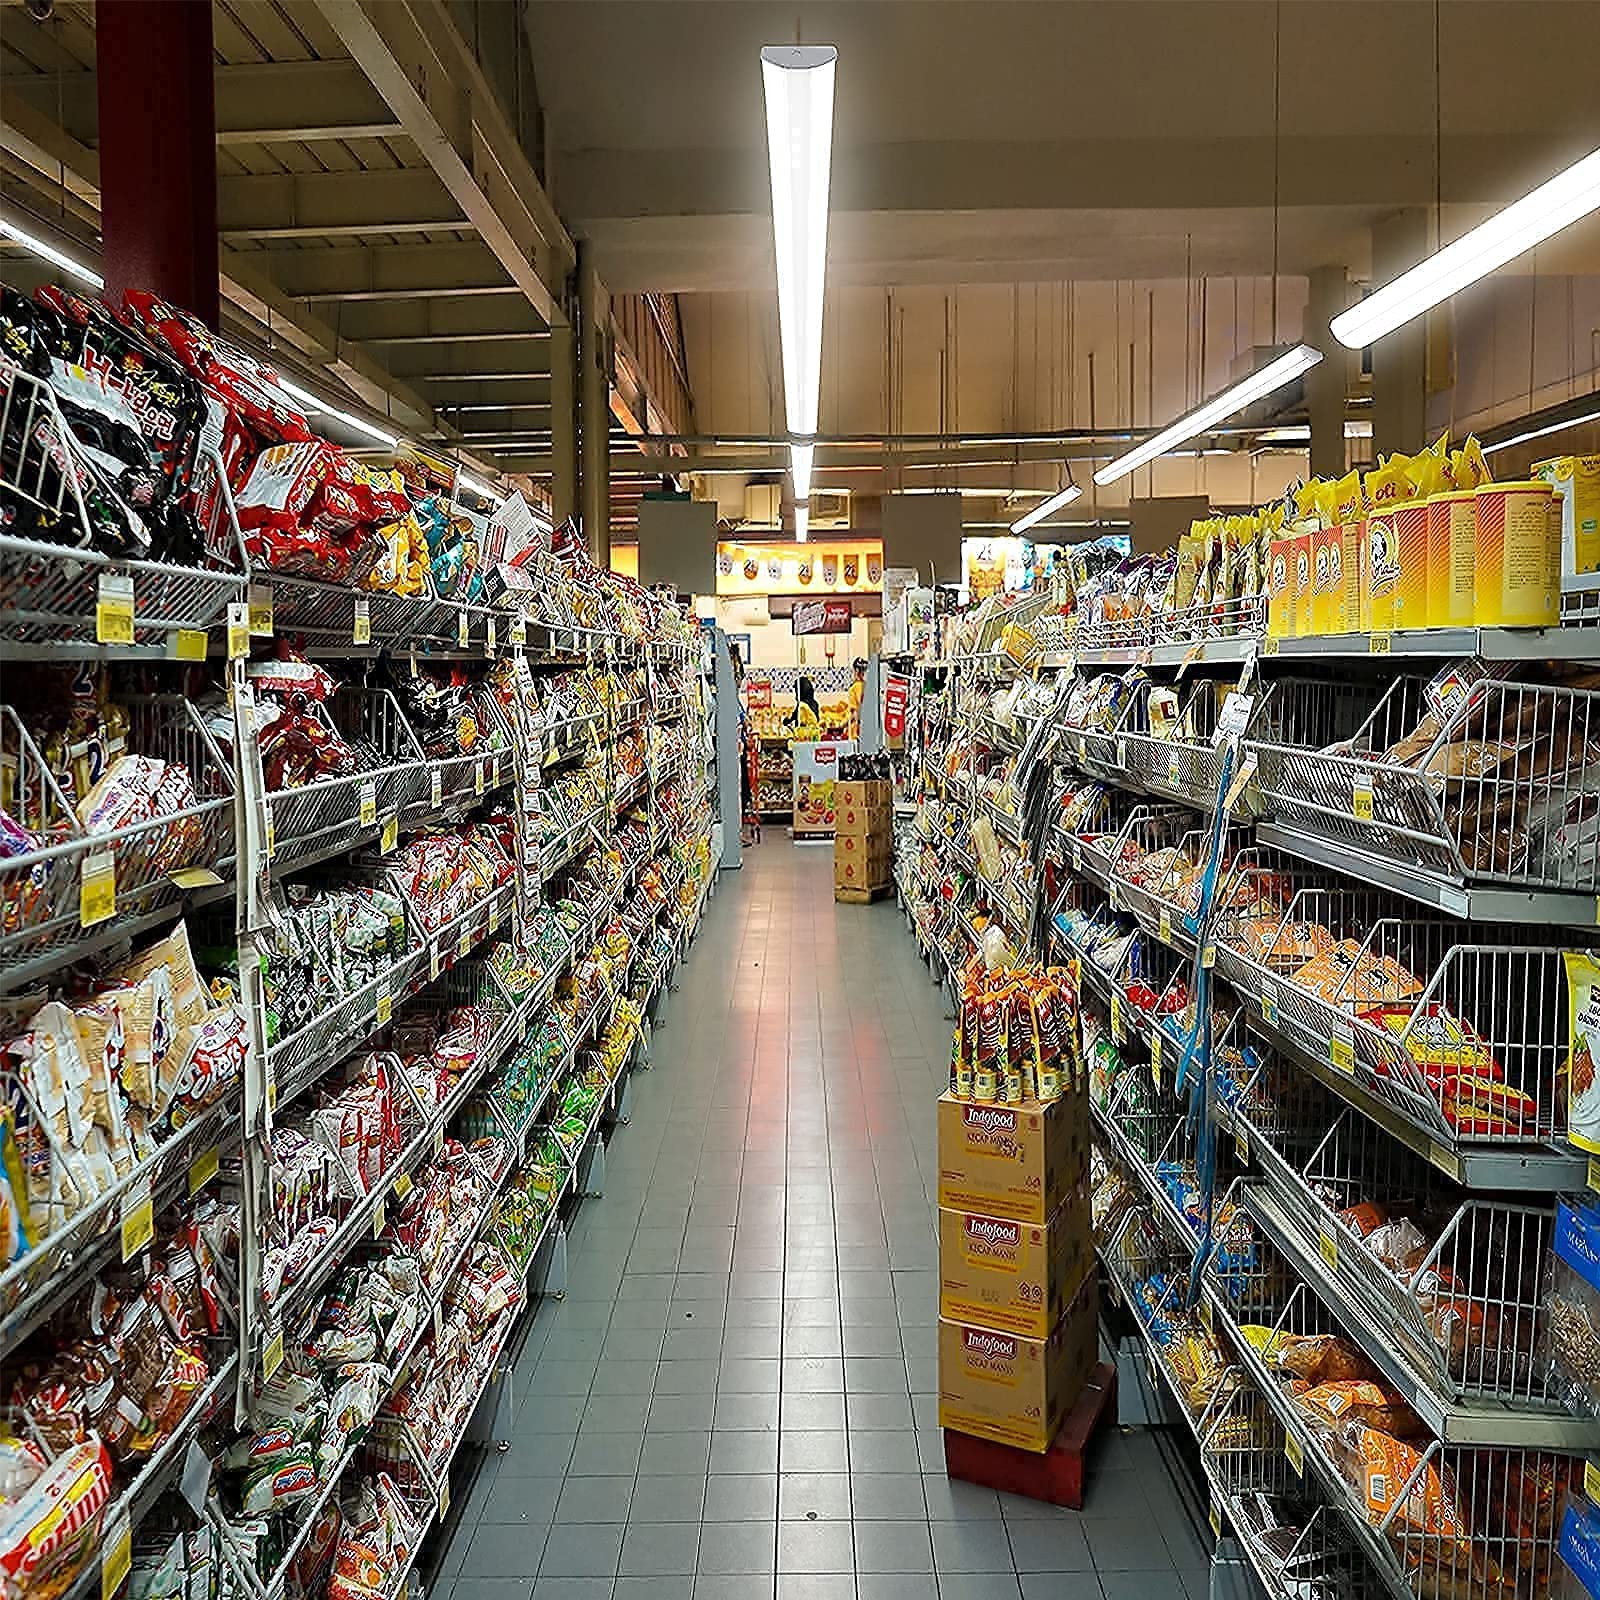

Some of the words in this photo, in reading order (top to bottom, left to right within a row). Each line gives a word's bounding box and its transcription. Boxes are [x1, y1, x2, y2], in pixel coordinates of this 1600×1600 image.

[967, 1108, 1015, 1130] Indofood
[970, 1219, 1017, 1241] Indofood
[967, 1331, 1014, 1354] Indofood
